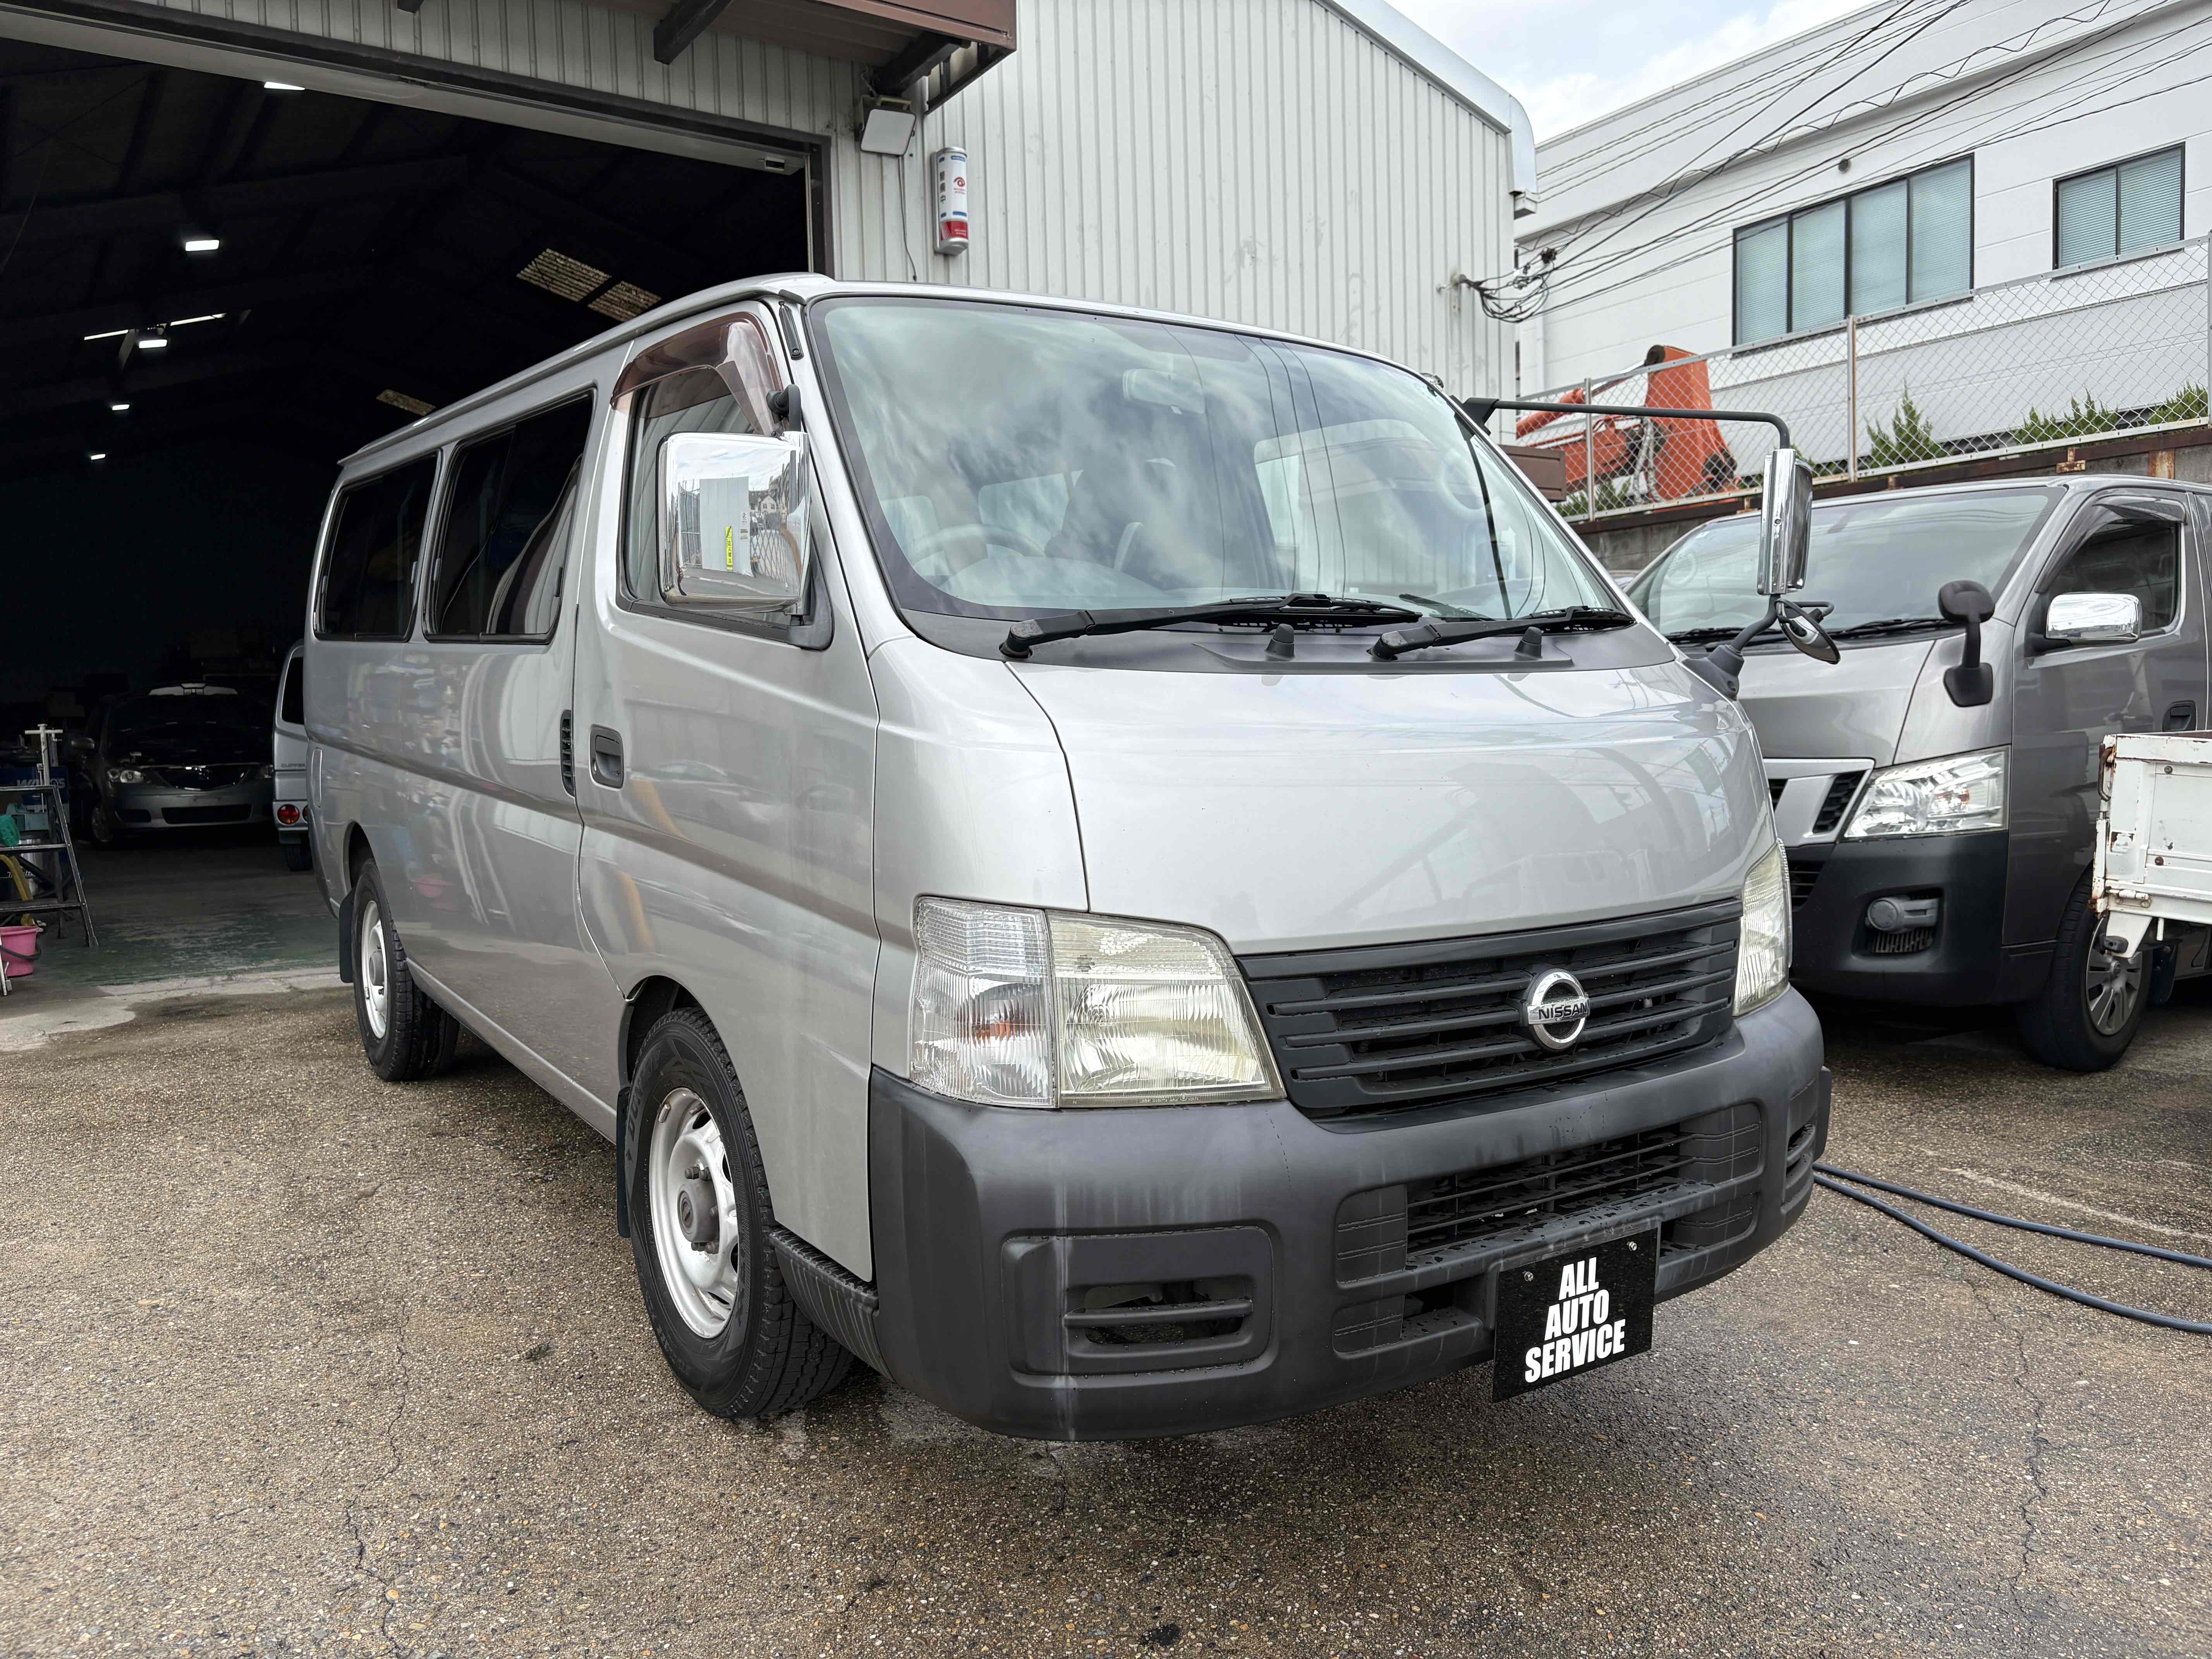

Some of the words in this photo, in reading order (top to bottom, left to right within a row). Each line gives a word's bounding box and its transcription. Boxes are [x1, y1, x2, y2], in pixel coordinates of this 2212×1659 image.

[1539, 1003, 1587, 1020] NISSAN
[1559, 1257, 1599, 1300] ALL
[1544, 1289, 1609, 1341] AUTO
[1525, 1319, 1625, 1383] SERVICE
